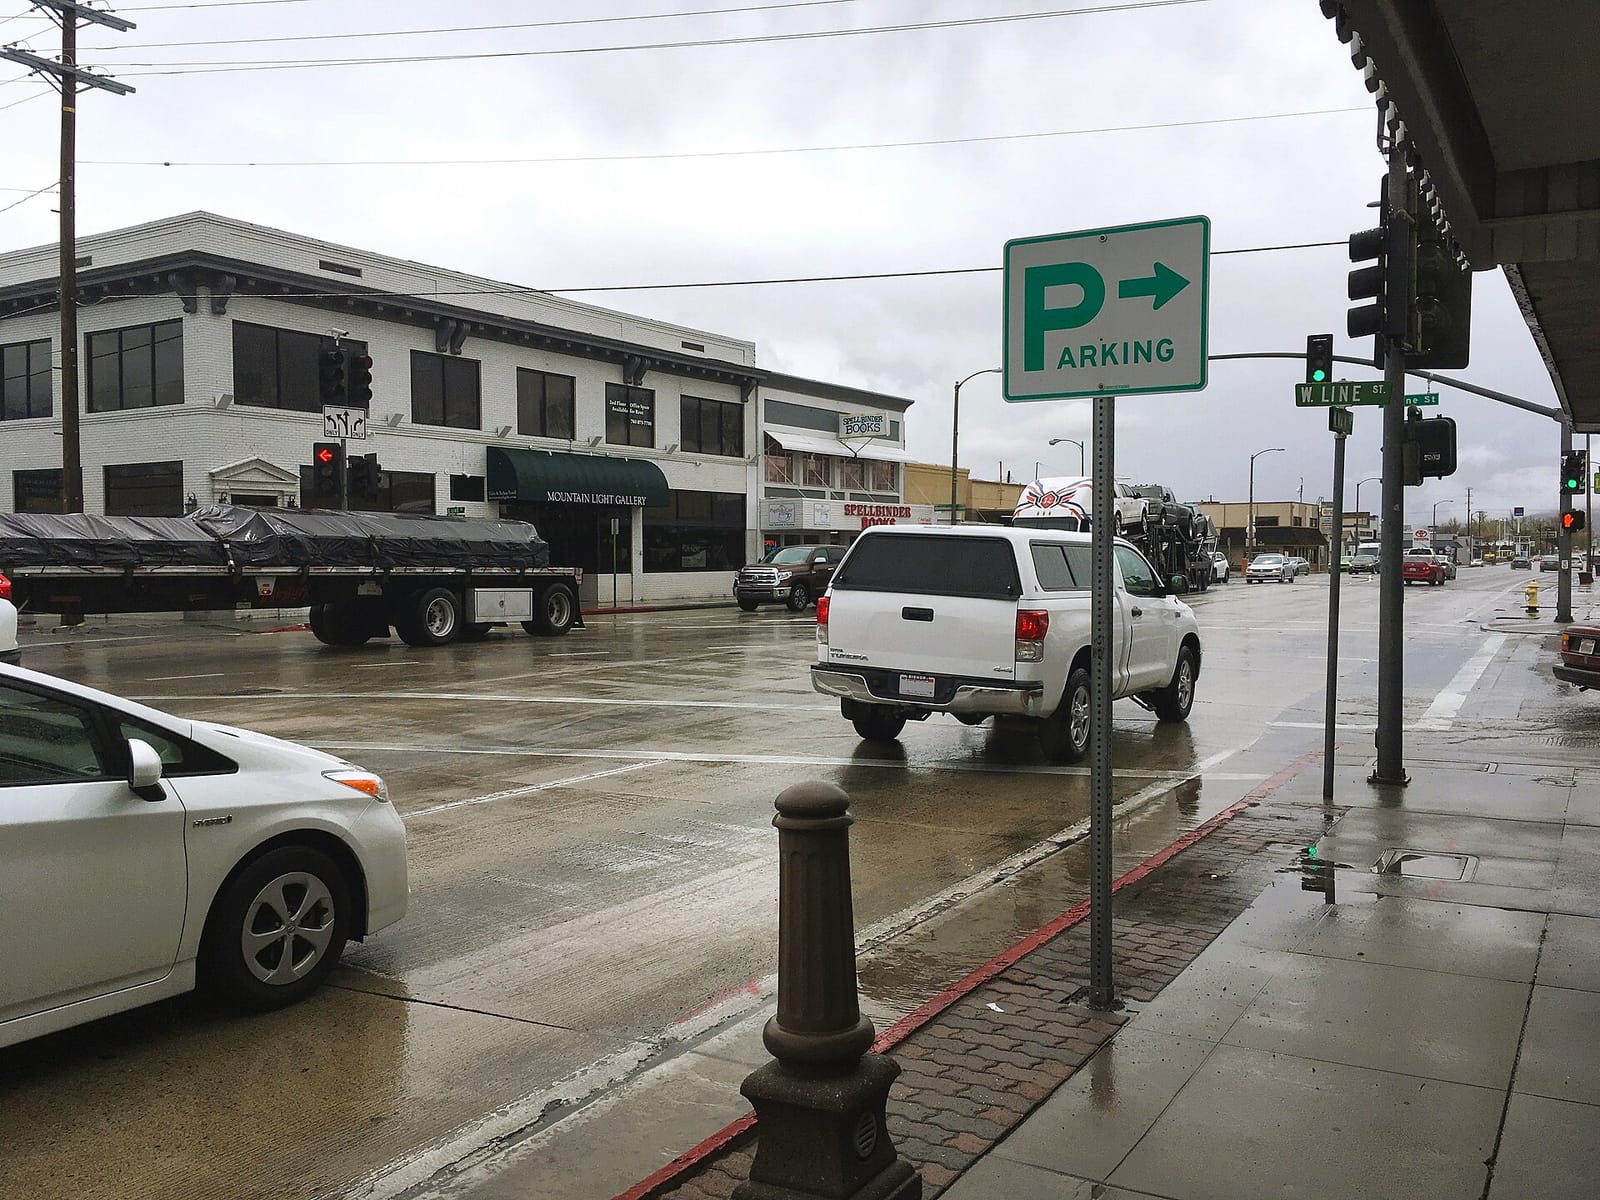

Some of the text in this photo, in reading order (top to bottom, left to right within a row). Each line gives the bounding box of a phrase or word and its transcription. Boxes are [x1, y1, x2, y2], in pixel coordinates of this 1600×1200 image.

[1321, 385, 1361, 403] LINE
[1423, 395, 1436, 403] St
[843, 415, 883, 425] SPELLBINDER
[846, 423, 880, 434] BOOKS
[547, 491, 646, 506] MOUNTAIN LIGHT GALLERY
[844, 504, 911, 518] SPELLBINDER
[830, 653, 869, 661] TUNDRA
